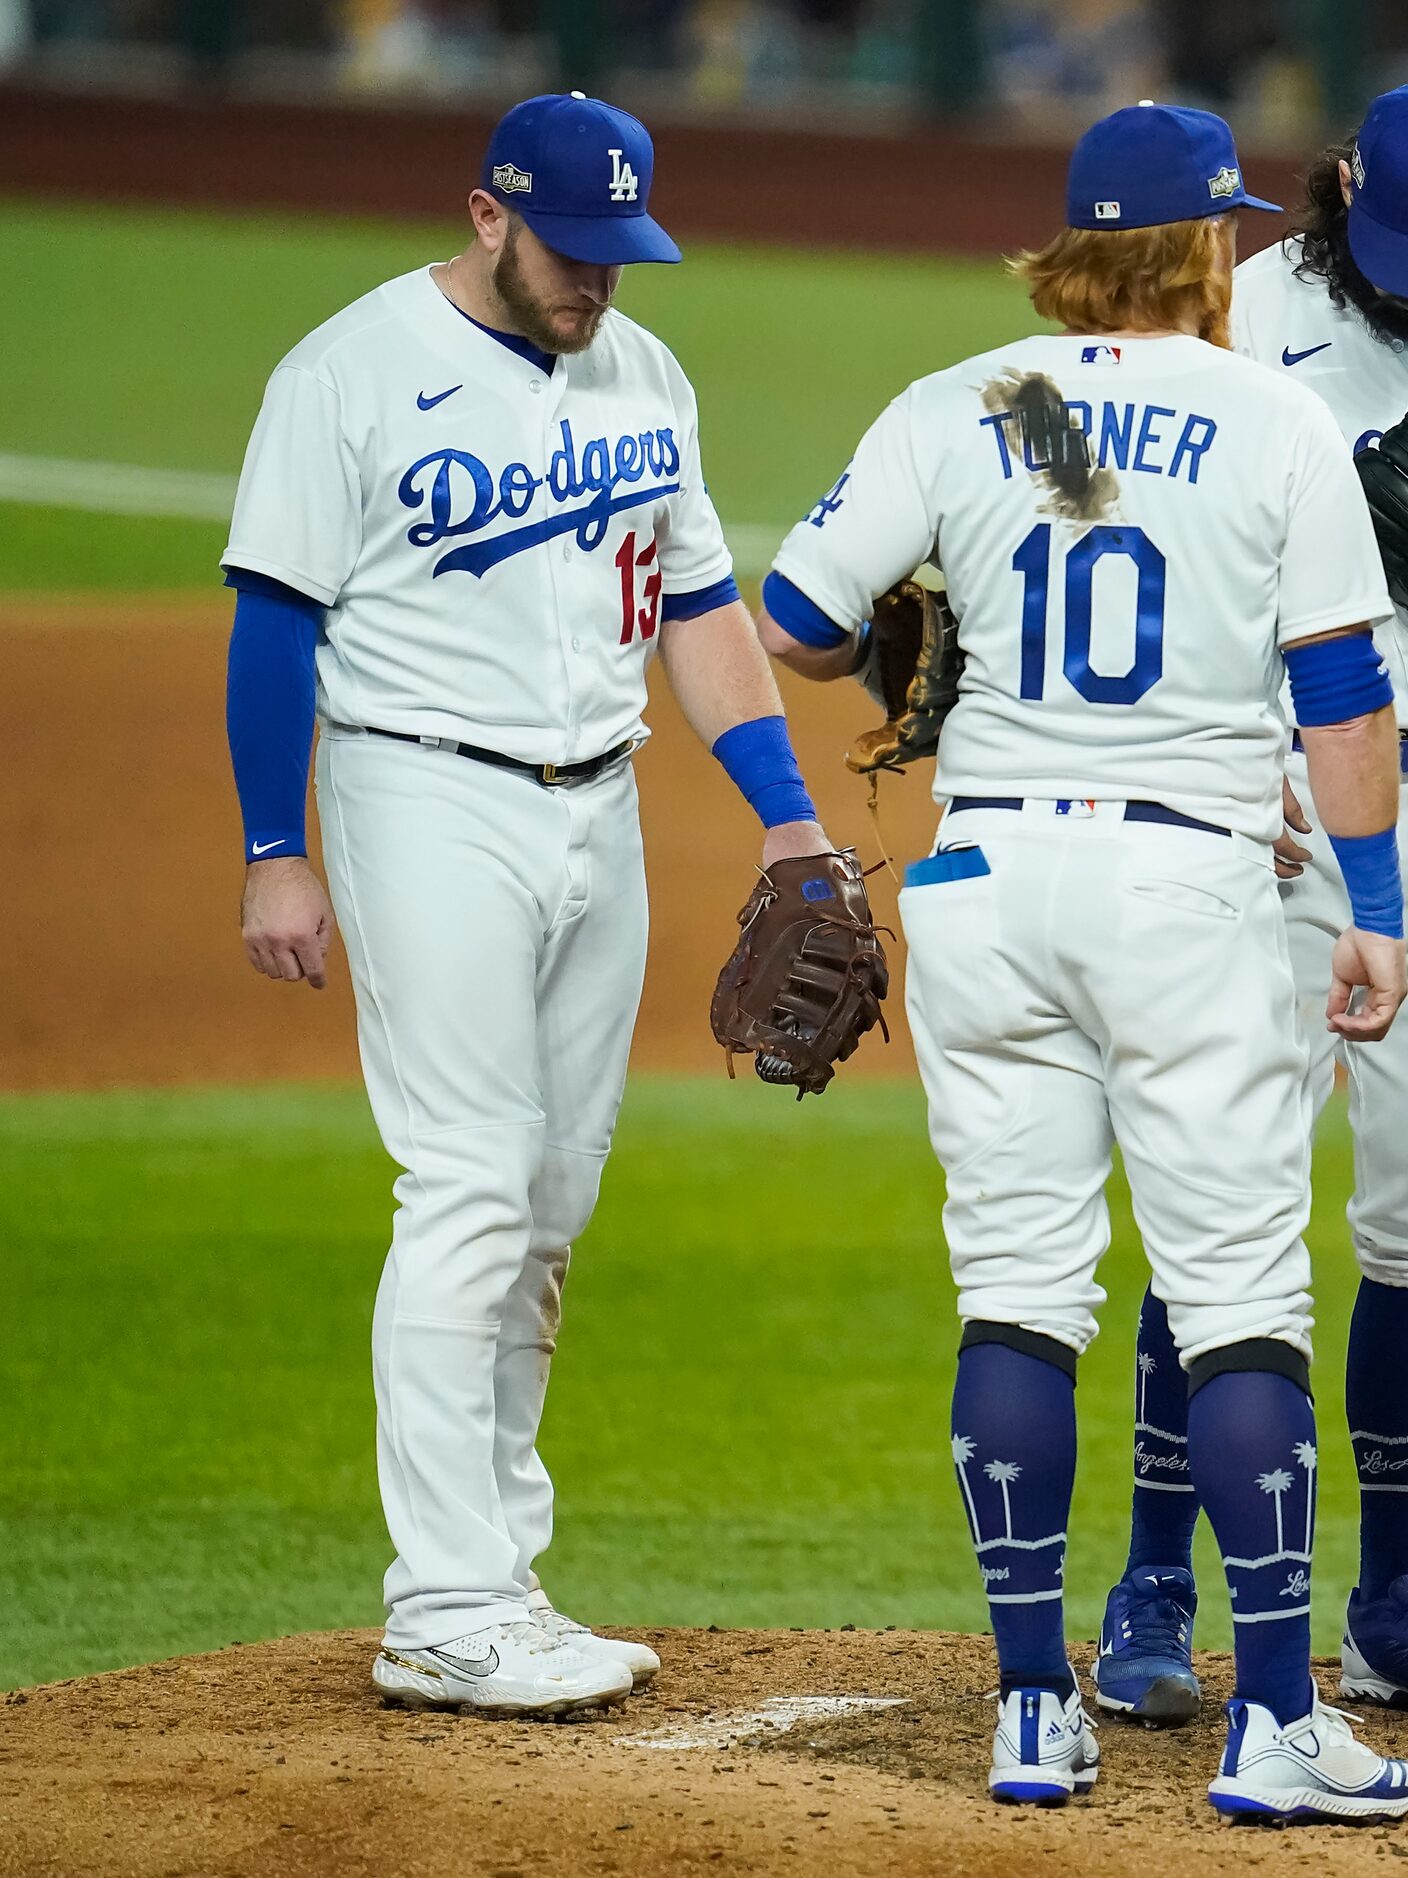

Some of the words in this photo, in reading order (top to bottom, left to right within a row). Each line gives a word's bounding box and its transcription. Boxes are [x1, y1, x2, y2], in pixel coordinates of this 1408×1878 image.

[608, 149, 638, 201] LA
[398, 418, 680, 552] Dodgers
[615, 531, 662, 645] 13
[1012, 523, 1166, 705] 10
[1360, 1450, 1389, 1474] Los
